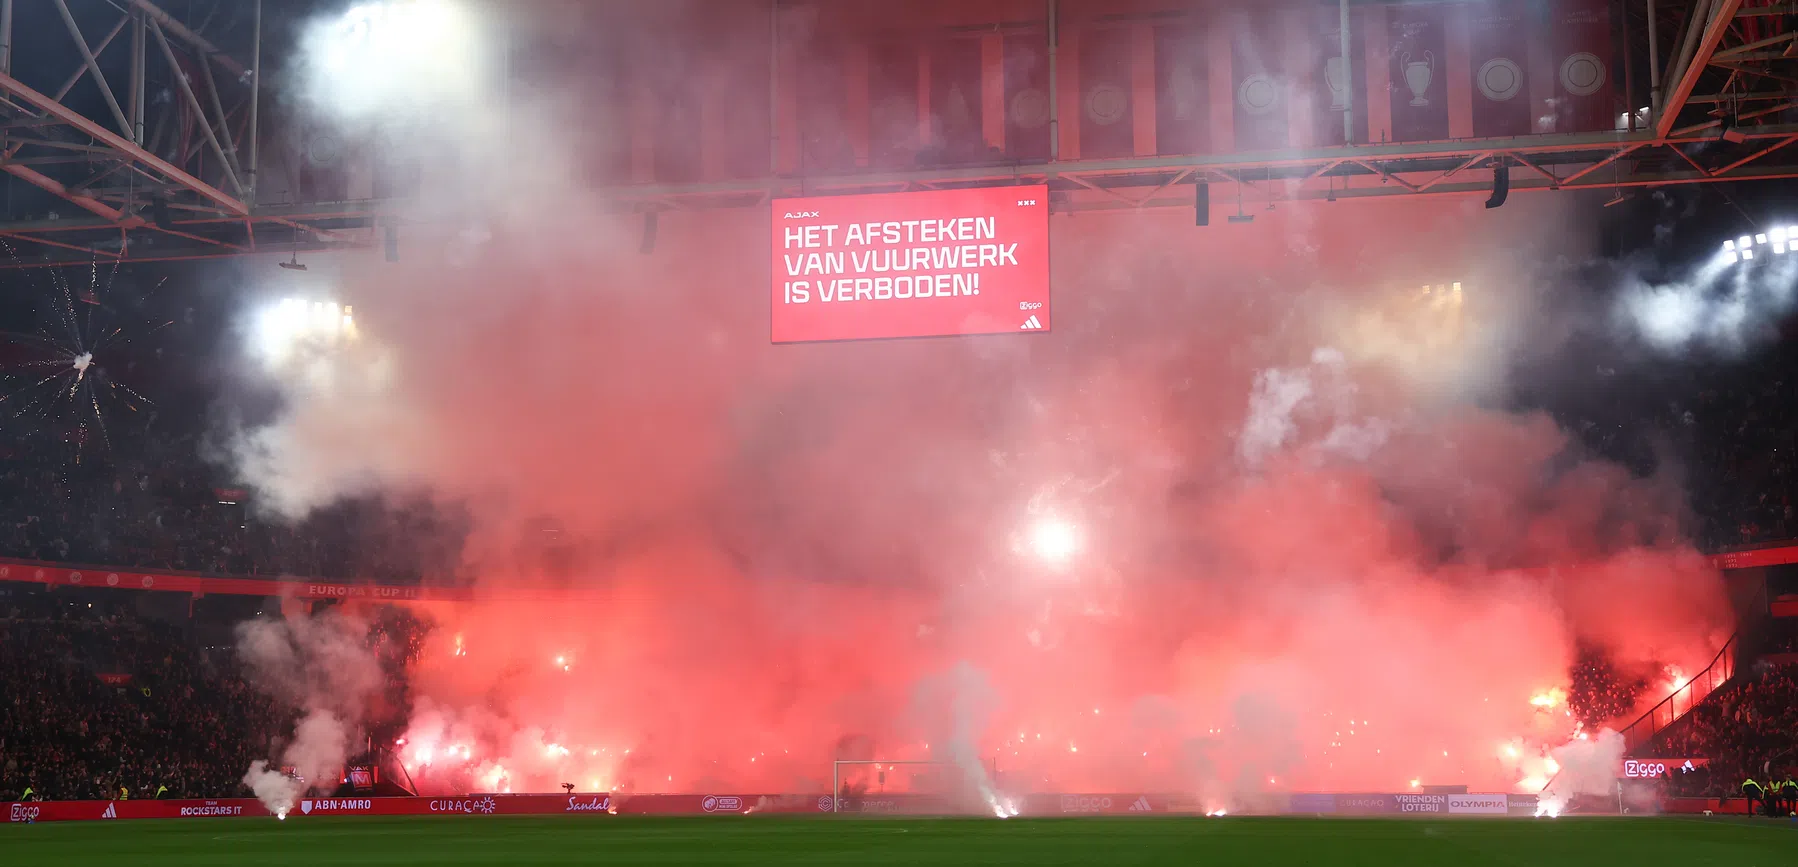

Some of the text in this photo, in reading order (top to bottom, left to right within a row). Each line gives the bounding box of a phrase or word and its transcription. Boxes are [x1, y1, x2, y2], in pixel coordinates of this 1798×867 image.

[784, 211, 819, 219] AJAX
[784, 216, 995, 248] HET AFSTEKEN
[784, 243, 1018, 276] VAN VUURWERK
[784, 273, 980, 304] IS VERBODEN!
[309, 586, 365, 596] EUROPA
[372, 588, 400, 597] CUP
[1625, 760, 1664, 777] Ziggo
[10, 804, 40, 821] Ziggo
[181, 806, 242, 816] ROCKSTARS IT
[430, 798, 494, 813] CURAÇAO
[1402, 804, 1439, 812] LOTERIJ
